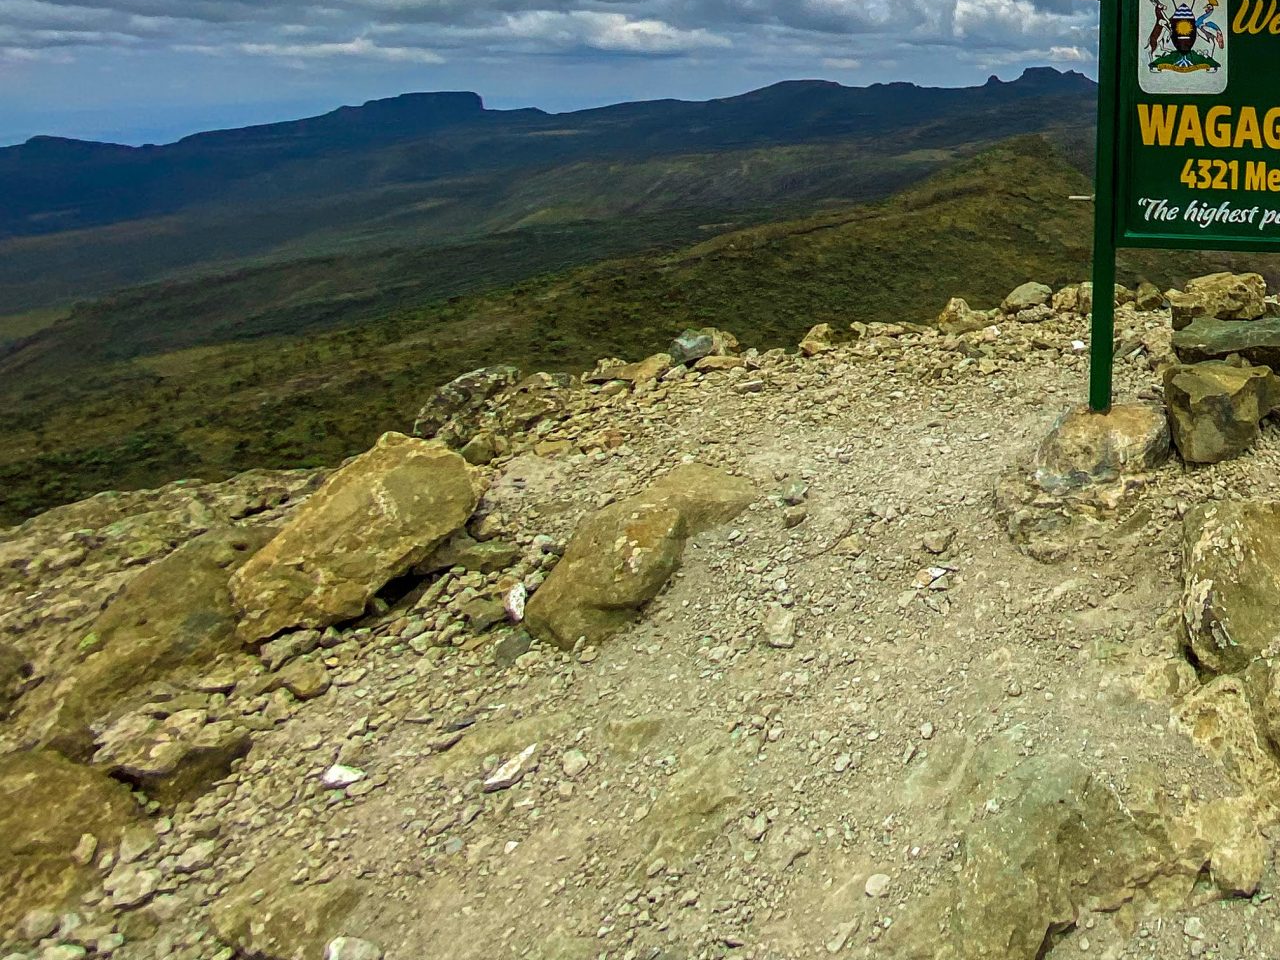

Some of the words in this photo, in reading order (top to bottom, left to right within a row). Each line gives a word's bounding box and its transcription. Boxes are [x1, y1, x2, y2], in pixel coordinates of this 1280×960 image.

[1180, 159, 1239, 190] 4321
[1138, 197, 1179, 221] “The
[1183, 200, 1259, 228] highest
